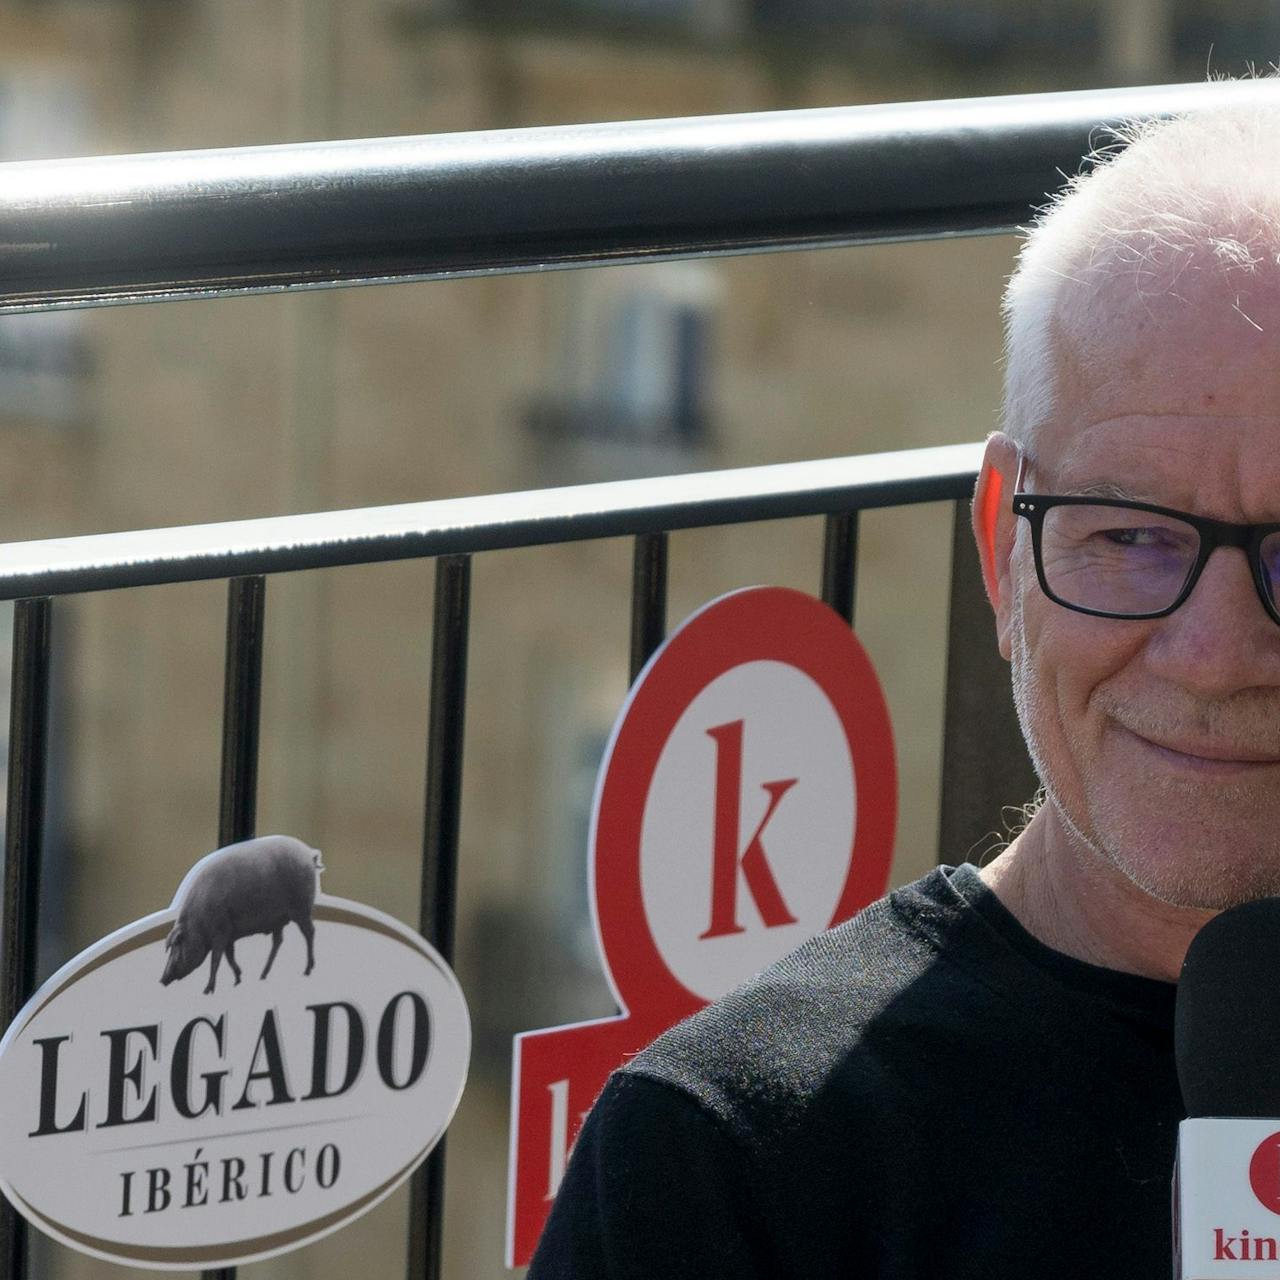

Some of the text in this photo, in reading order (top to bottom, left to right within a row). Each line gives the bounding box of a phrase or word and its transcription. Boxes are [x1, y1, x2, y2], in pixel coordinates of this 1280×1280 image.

[699, 719, 799, 940] k
[28, 991, 432, 1138] LEGADO
[118, 1144, 342, 1218] IBÉRICO
